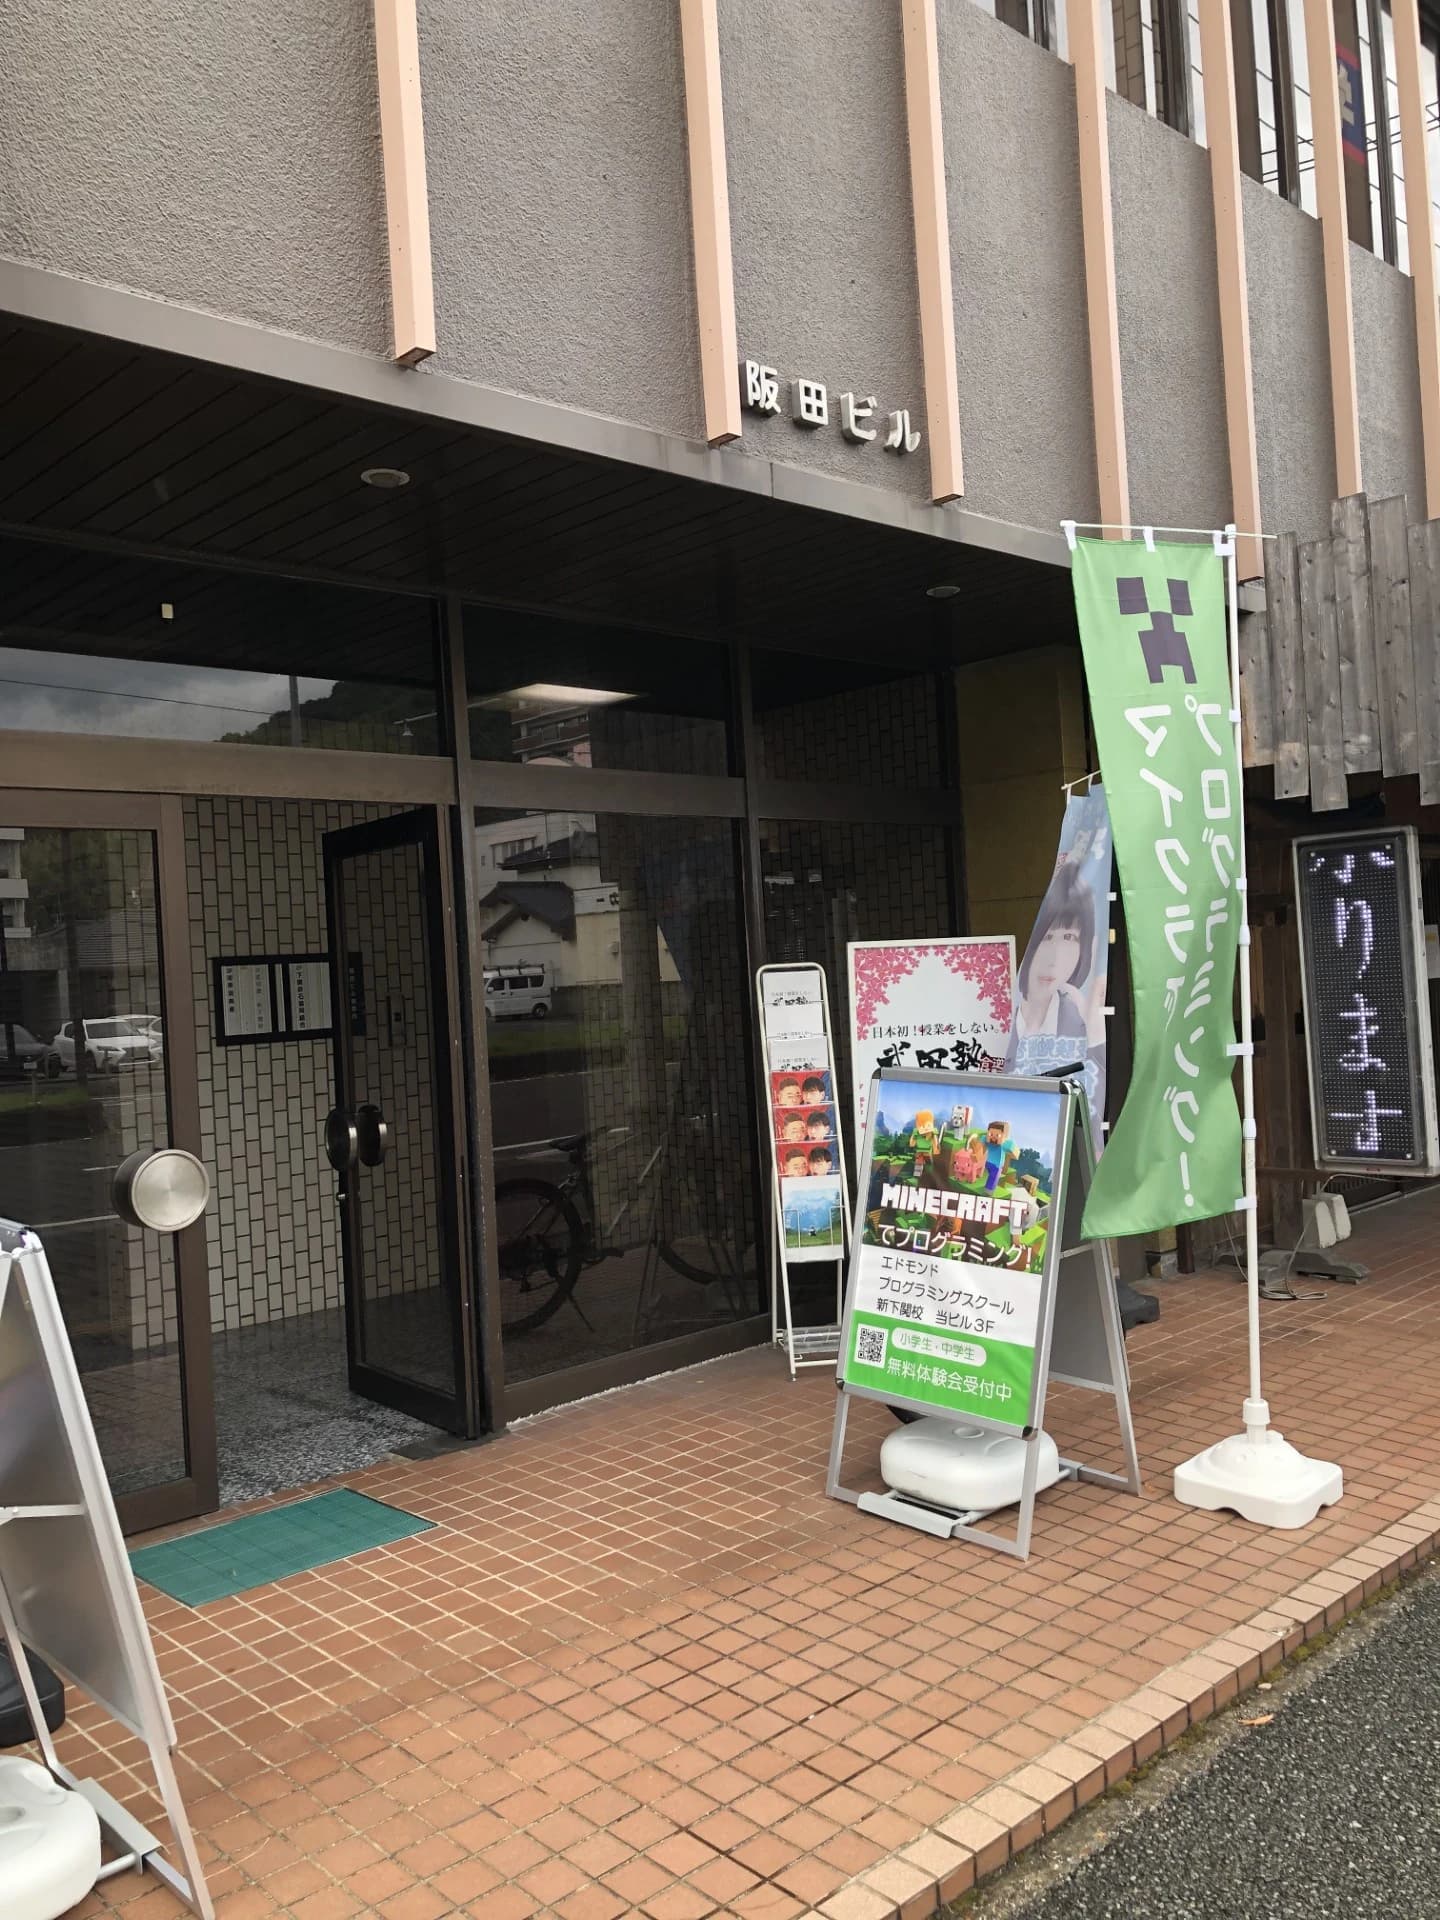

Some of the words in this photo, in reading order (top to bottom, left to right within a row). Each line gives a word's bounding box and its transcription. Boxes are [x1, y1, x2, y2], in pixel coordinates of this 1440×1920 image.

[743, 359, 921, 452] 阪田ビル
[880, 1183, 1028, 1227] MINECRAFT
[881, 1256, 939, 1277] エドモンド
[876, 1297, 924, 1321] 新下関校
[879, 1277, 1014, 1315] プログラミングスクール
[900, 1333, 977, 1361] 小学生・中学生
[887, 1357, 1012, 1403] 無料体験会受付中
